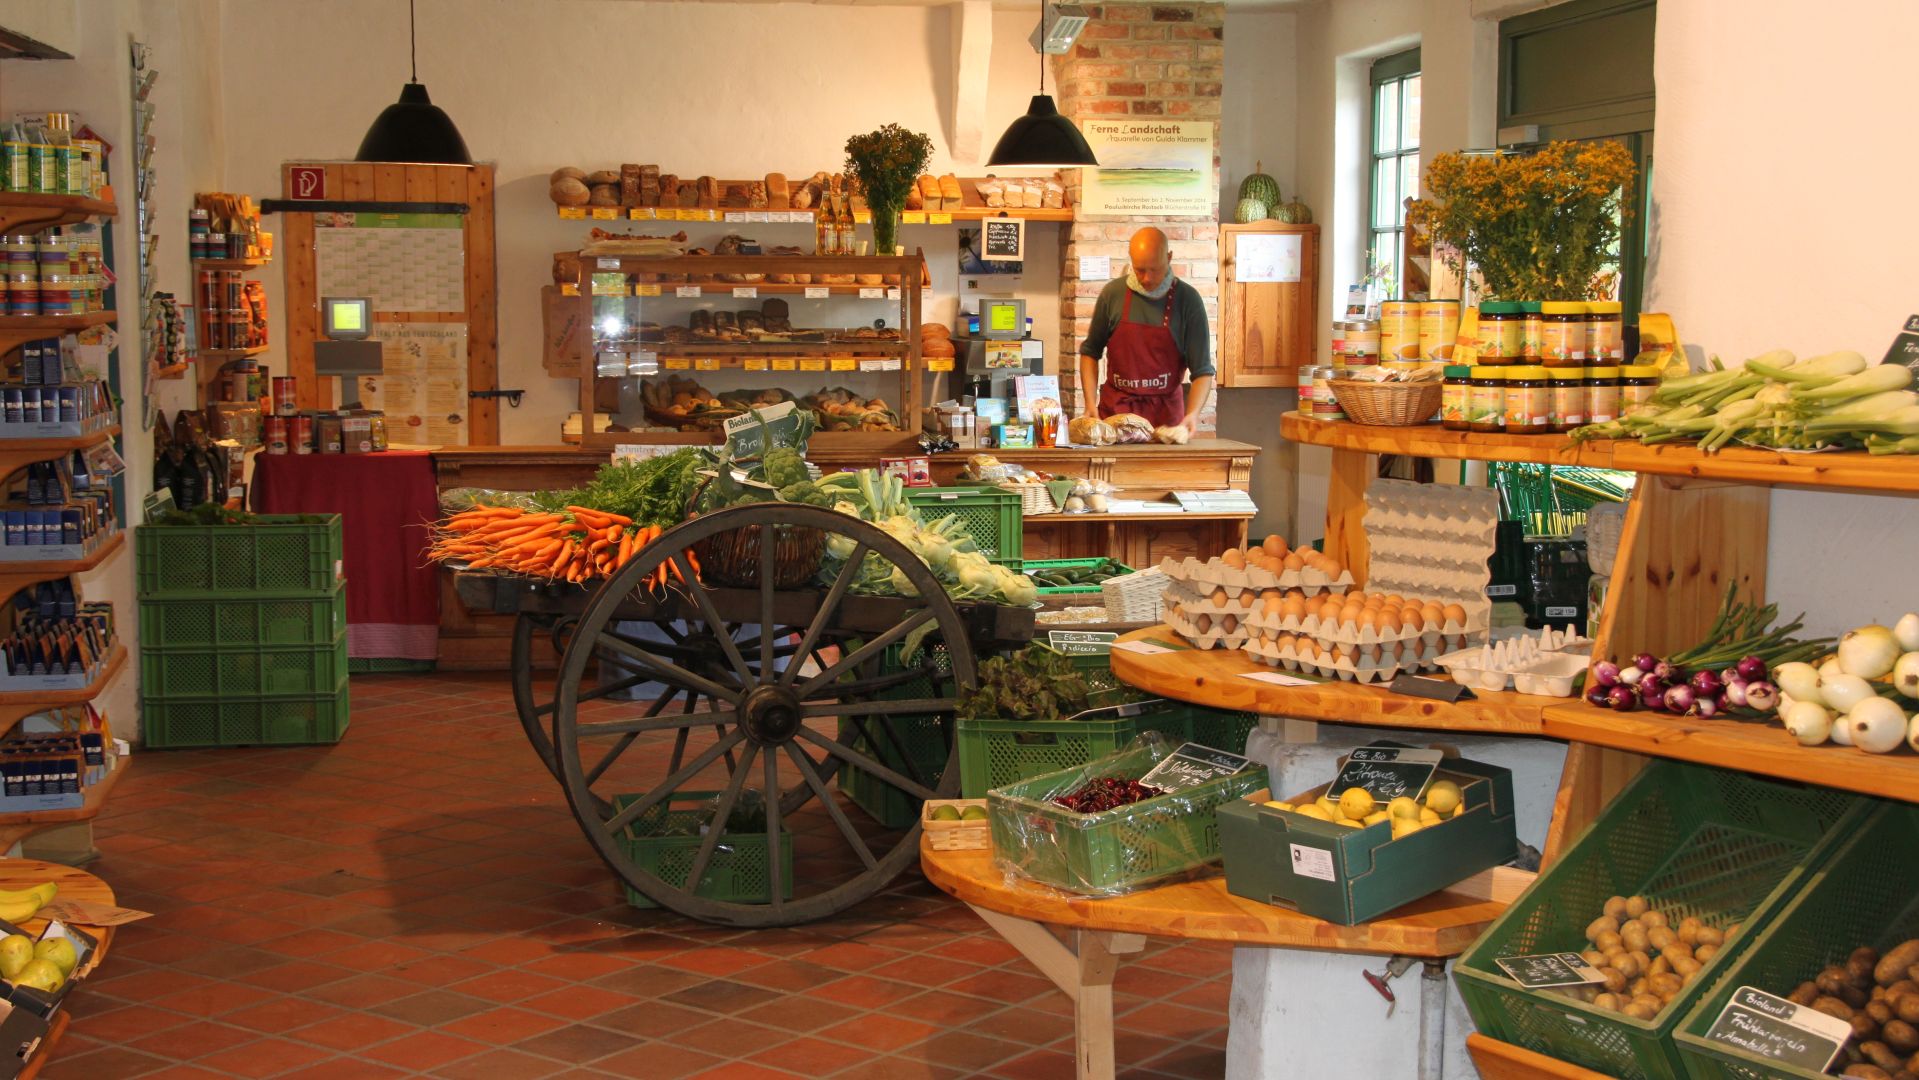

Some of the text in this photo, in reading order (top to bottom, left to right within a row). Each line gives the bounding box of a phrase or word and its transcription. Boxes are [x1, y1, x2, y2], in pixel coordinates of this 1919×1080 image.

[1091, 125, 1181, 135] Ferne Landschaft
[1106, 135, 1140, 144] Aquarelle
[1155, 135, 1176, 143] Guido
[1122, 197, 1150, 205] September
[1117, 378, 1163, 388] ECHT BIO.
[727, 415, 757, 430] Biolan
[1745, 992, 1787, 1015] Bioland
